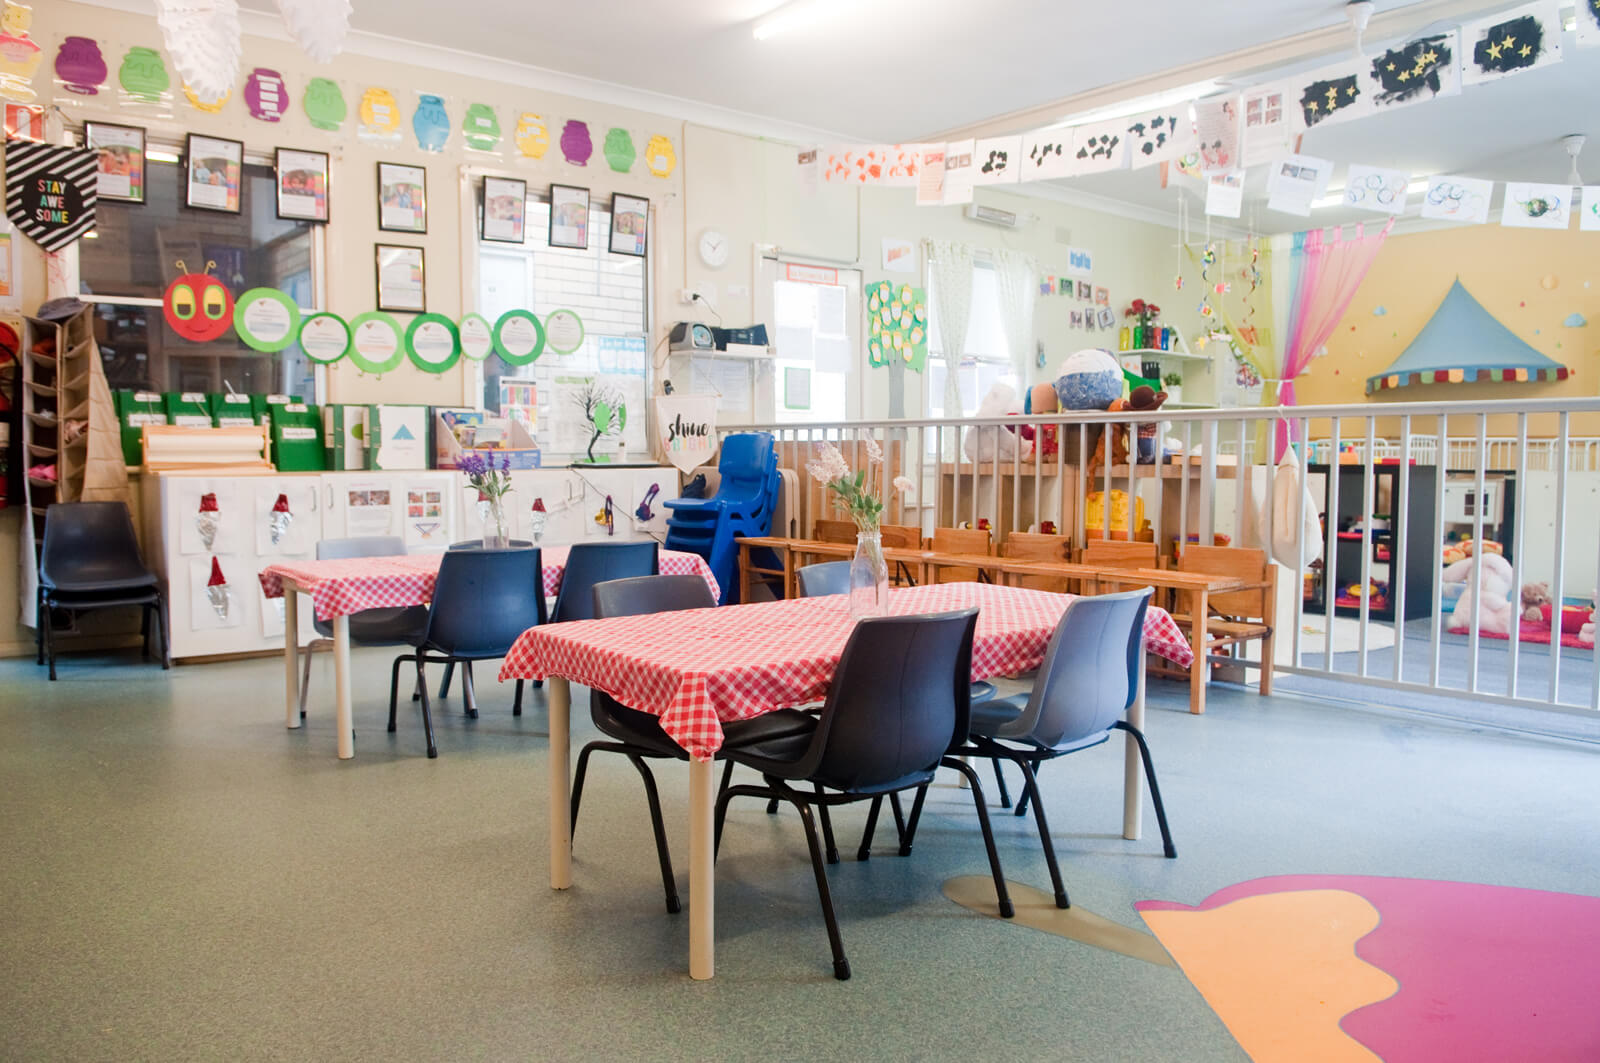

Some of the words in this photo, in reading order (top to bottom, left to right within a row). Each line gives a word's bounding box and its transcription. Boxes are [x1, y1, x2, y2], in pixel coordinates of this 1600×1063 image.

[37, 179, 67, 194] STAY
[40, 195, 65, 209] AWE
[36, 208, 70, 224] SOME
[668, 413, 710, 442] shine
